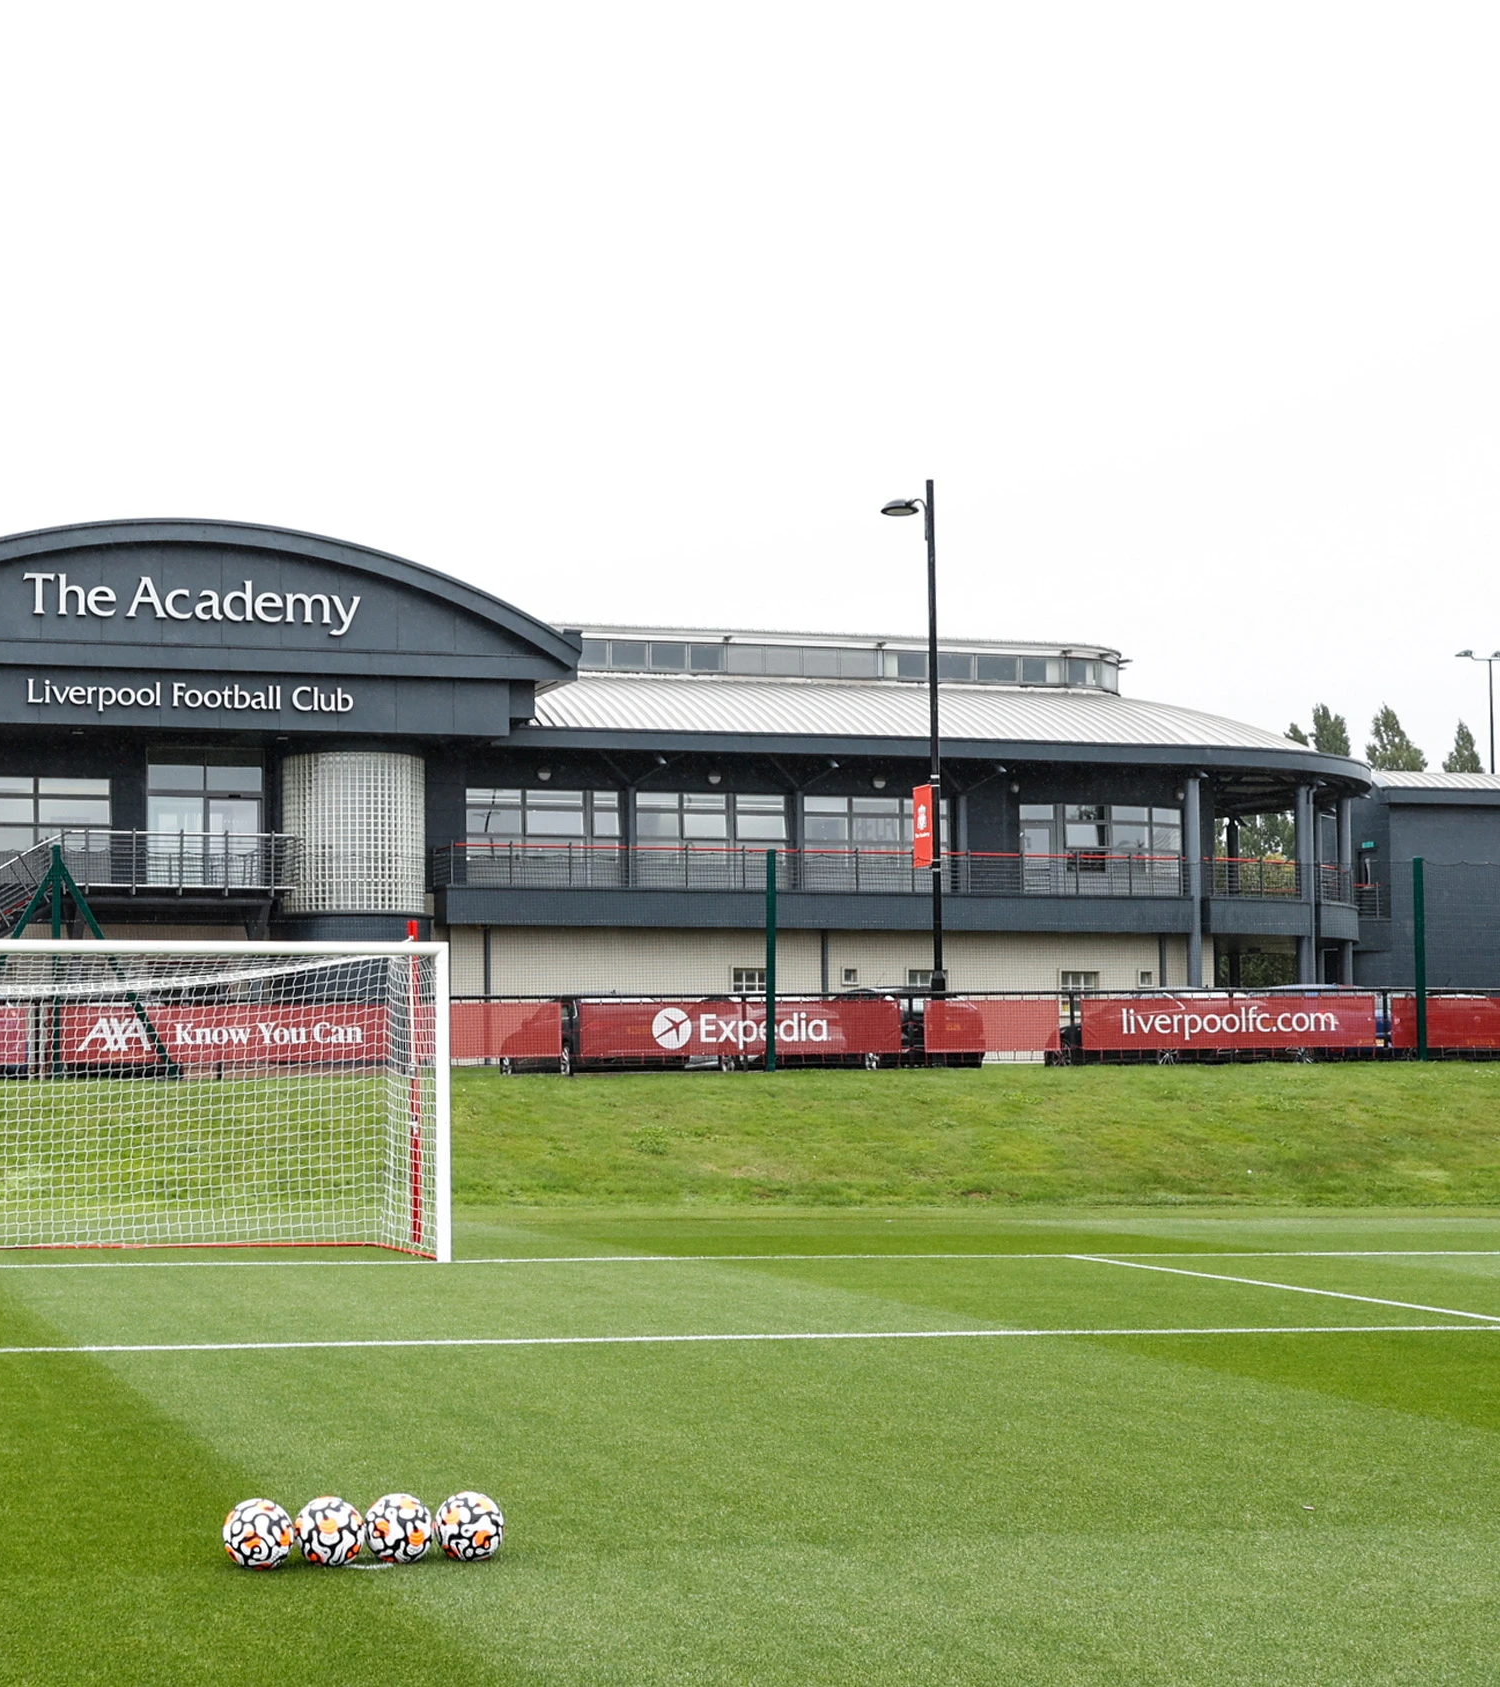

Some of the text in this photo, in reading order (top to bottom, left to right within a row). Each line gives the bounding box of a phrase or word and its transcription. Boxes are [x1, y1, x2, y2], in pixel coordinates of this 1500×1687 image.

[23, 572, 361, 636] The Academy
[27, 678, 354, 713] Liverpool Football Club
[76, 1018, 363, 1051] AXA Know You Can
[1121, 1006, 1337, 1041] liverpoolfc.com
